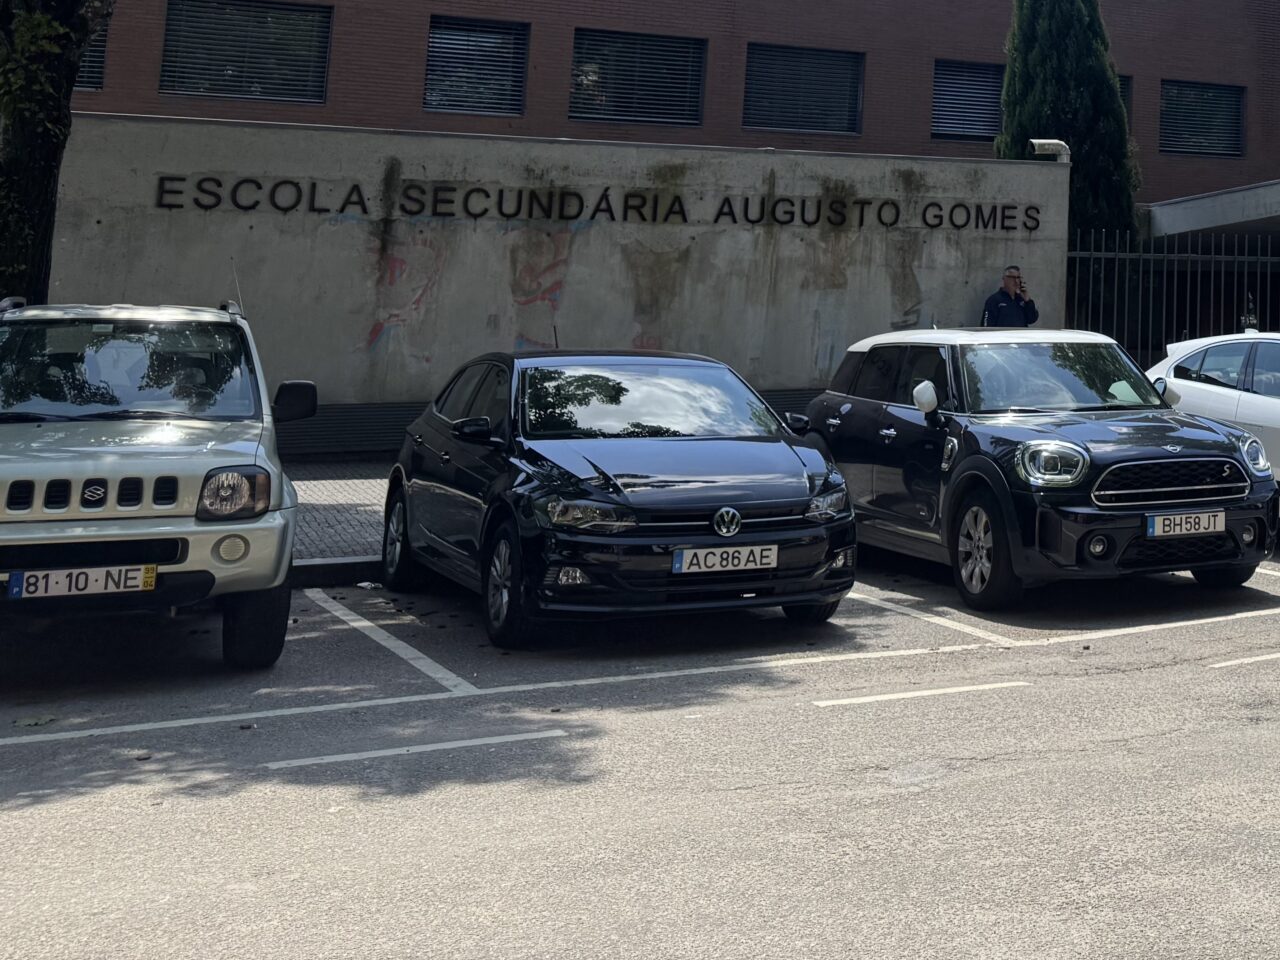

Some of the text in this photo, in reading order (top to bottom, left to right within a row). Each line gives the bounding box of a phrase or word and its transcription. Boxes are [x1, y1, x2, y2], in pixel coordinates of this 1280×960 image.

[155, 176, 1041, 232] ESCOLA SECUNDÁRIA AUGUSTO GOMES
[1222, 464, 1230, 477] S
[1162, 514, 1219, 533] BH58JT
[687, 548, 772, 570] AC86AE
[143, 580, 154, 588] 04
